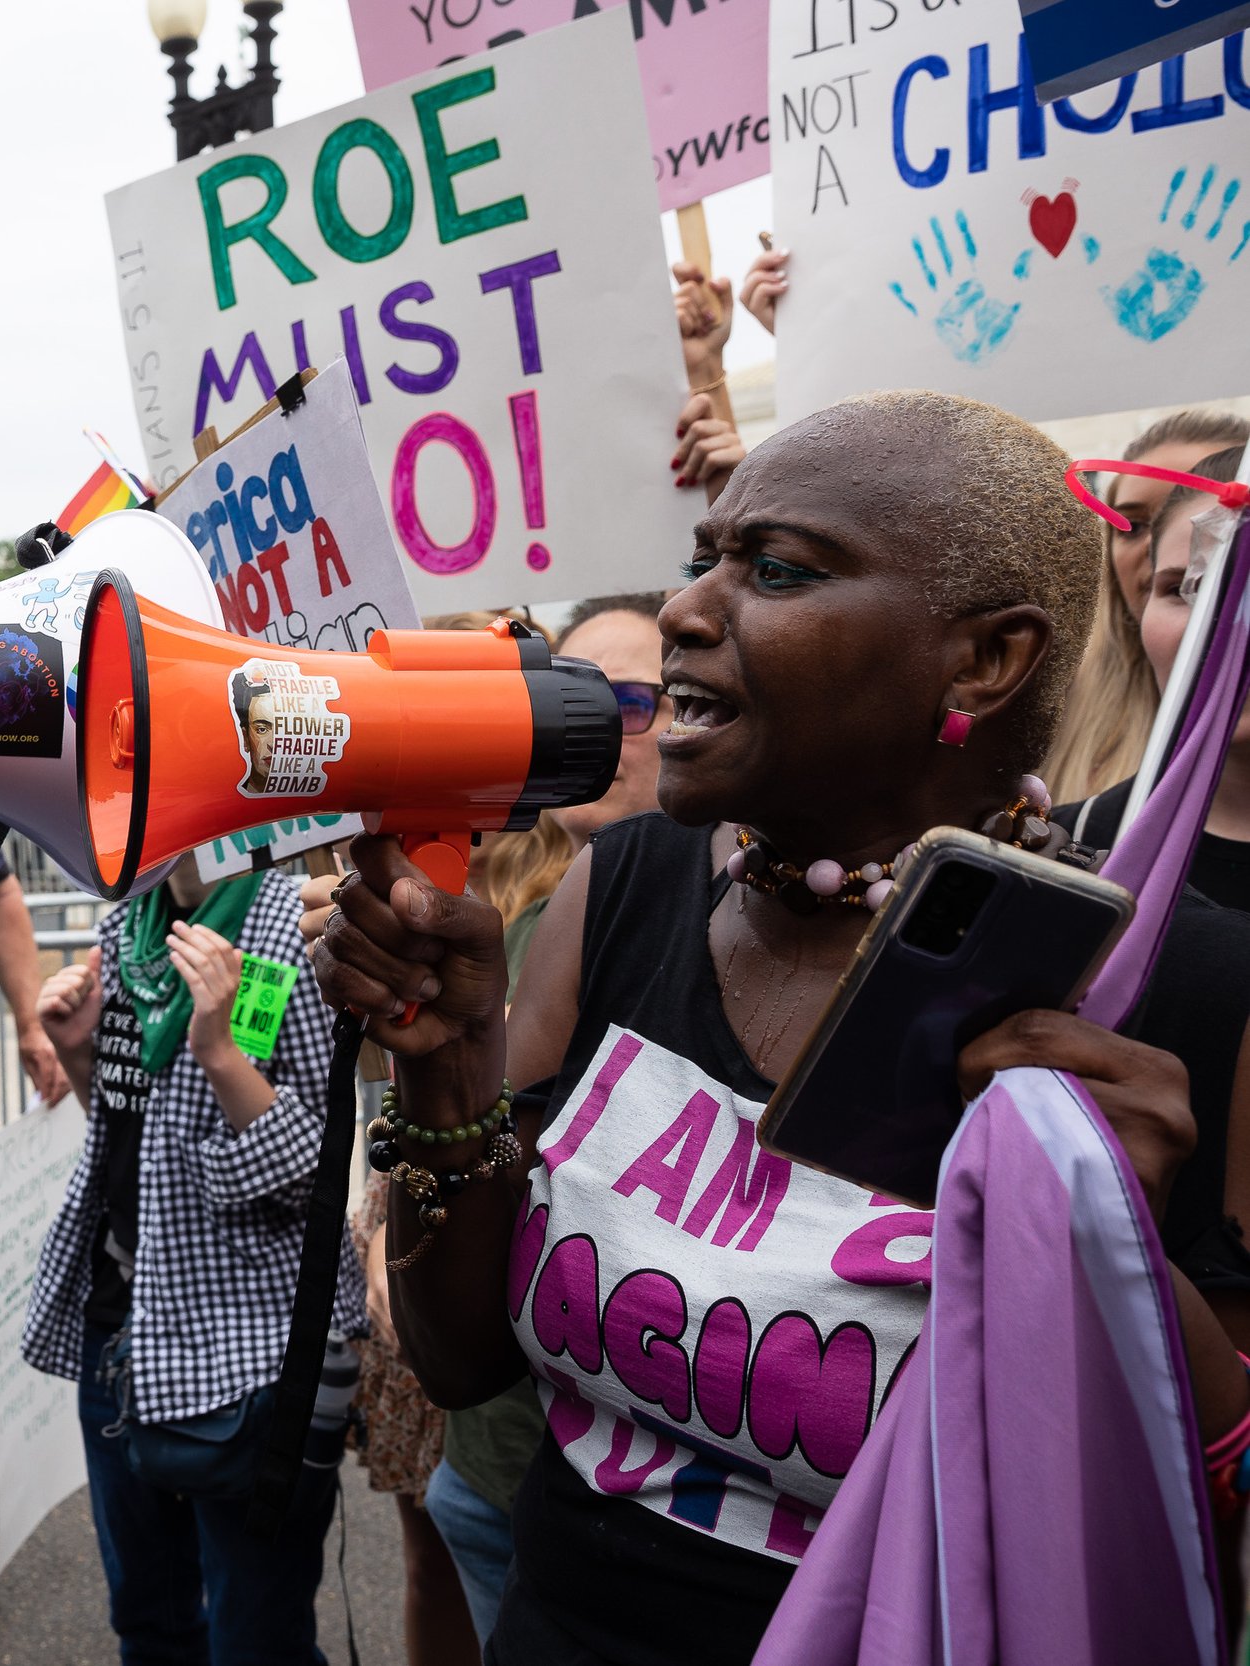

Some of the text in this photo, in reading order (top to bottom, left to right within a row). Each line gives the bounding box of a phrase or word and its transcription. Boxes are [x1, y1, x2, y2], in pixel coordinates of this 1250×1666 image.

[410, 0, 515, 44] YO
[782, 70, 871, 141] NOT
[196, 66, 528, 311] ROE
[812, 145, 849, 215] A
[391, 390, 552, 576] O!
[215, 541, 294, 638] NOT
[311, 516, 352, 598] A
[11, 645, 60, 698] ABORTION
[264, 663, 294, 677] NOT
[270, 679, 333, 695] FRAGILE
[271, 696, 321, 713] LIKE A
[274, 716, 344, 737] FLOWER
[270, 757, 315, 773] LIKE A
[273, 738, 337, 756] FRAGILE
[265, 776, 321, 793] BOMB
[541, 1032, 644, 1177] I
[611, 1089, 792, 1252] AM
[508, 1178, 921, 1479] VAGIN
